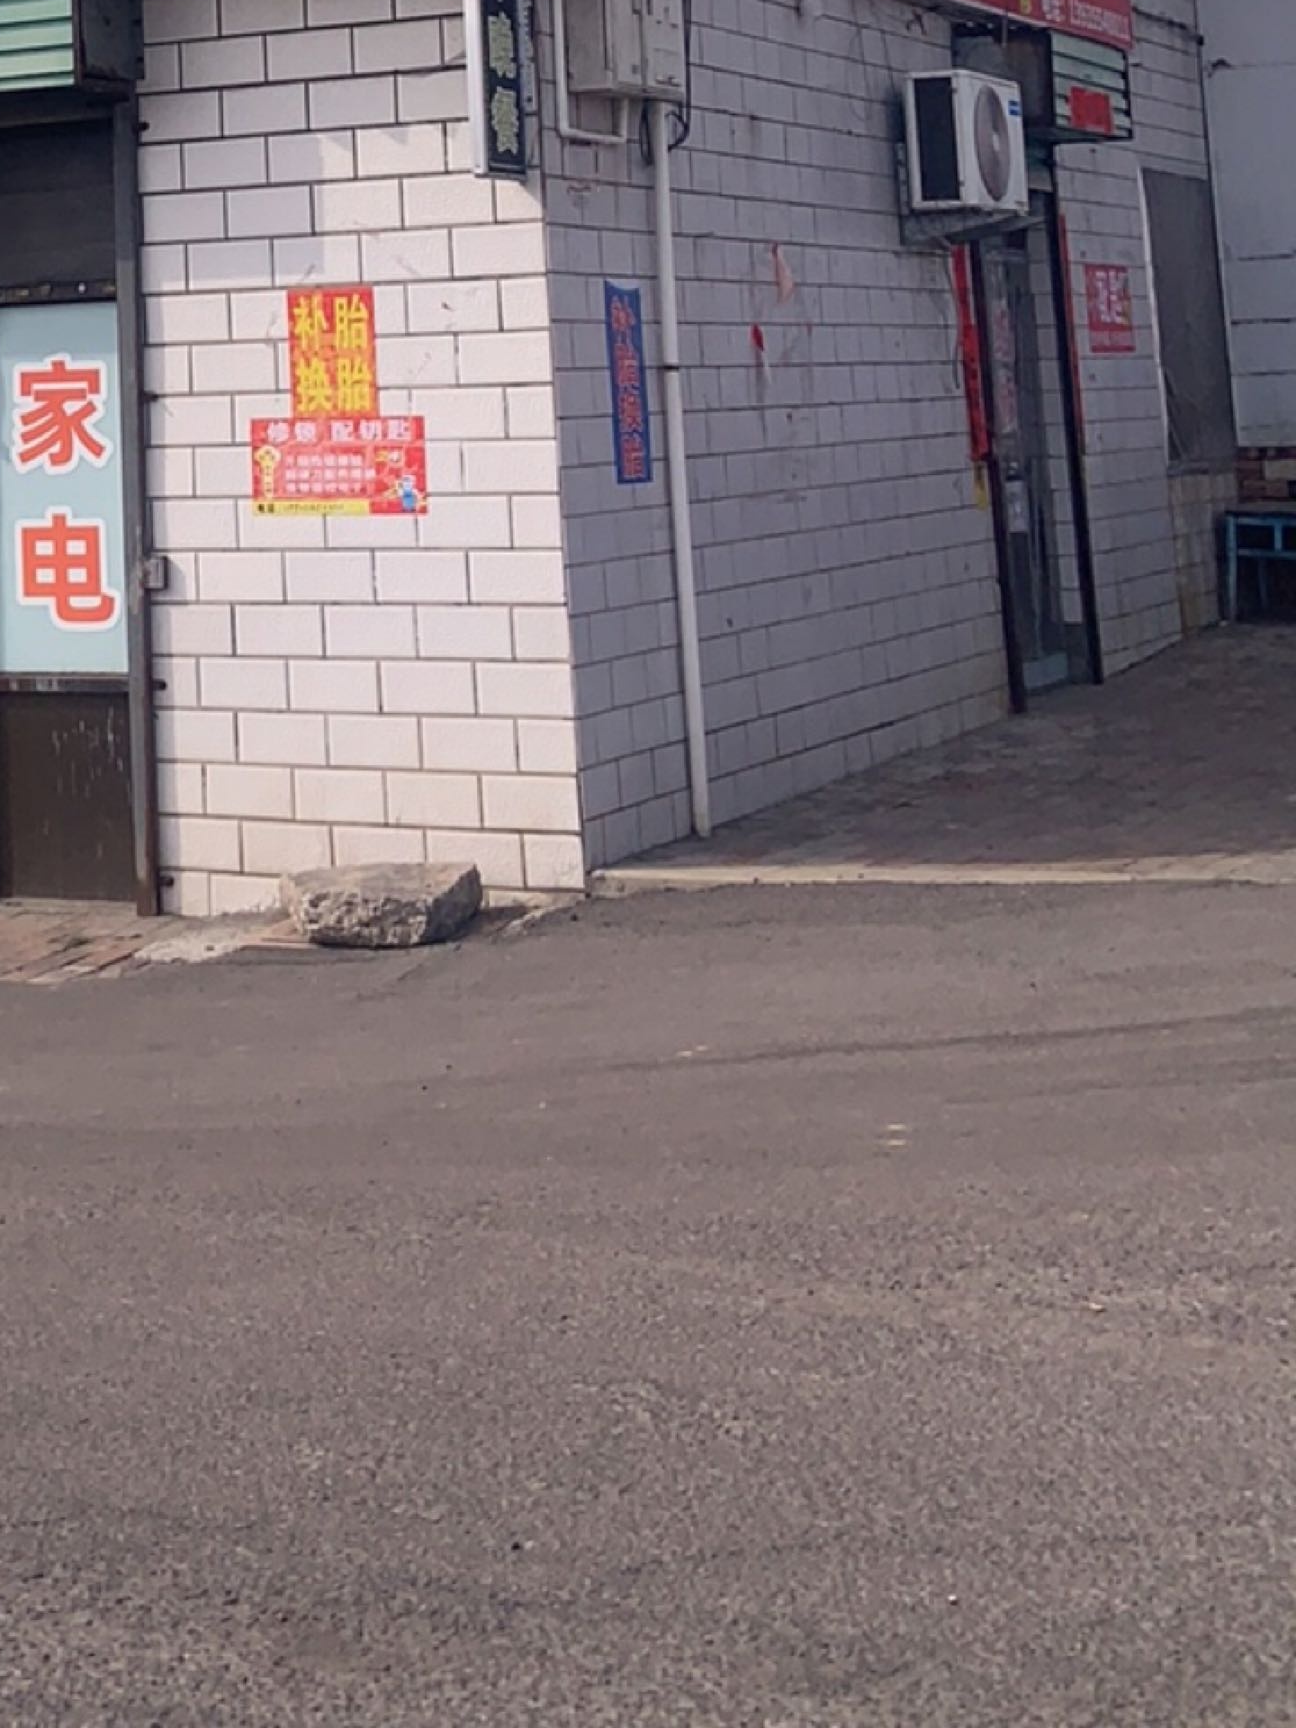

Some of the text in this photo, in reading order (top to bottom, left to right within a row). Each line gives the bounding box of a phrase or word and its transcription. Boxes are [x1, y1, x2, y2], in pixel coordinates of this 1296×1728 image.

[293, 292, 369, 350] 补胎
[297, 356, 371, 411] 换胎
[13, 355, 119, 631] 家电
